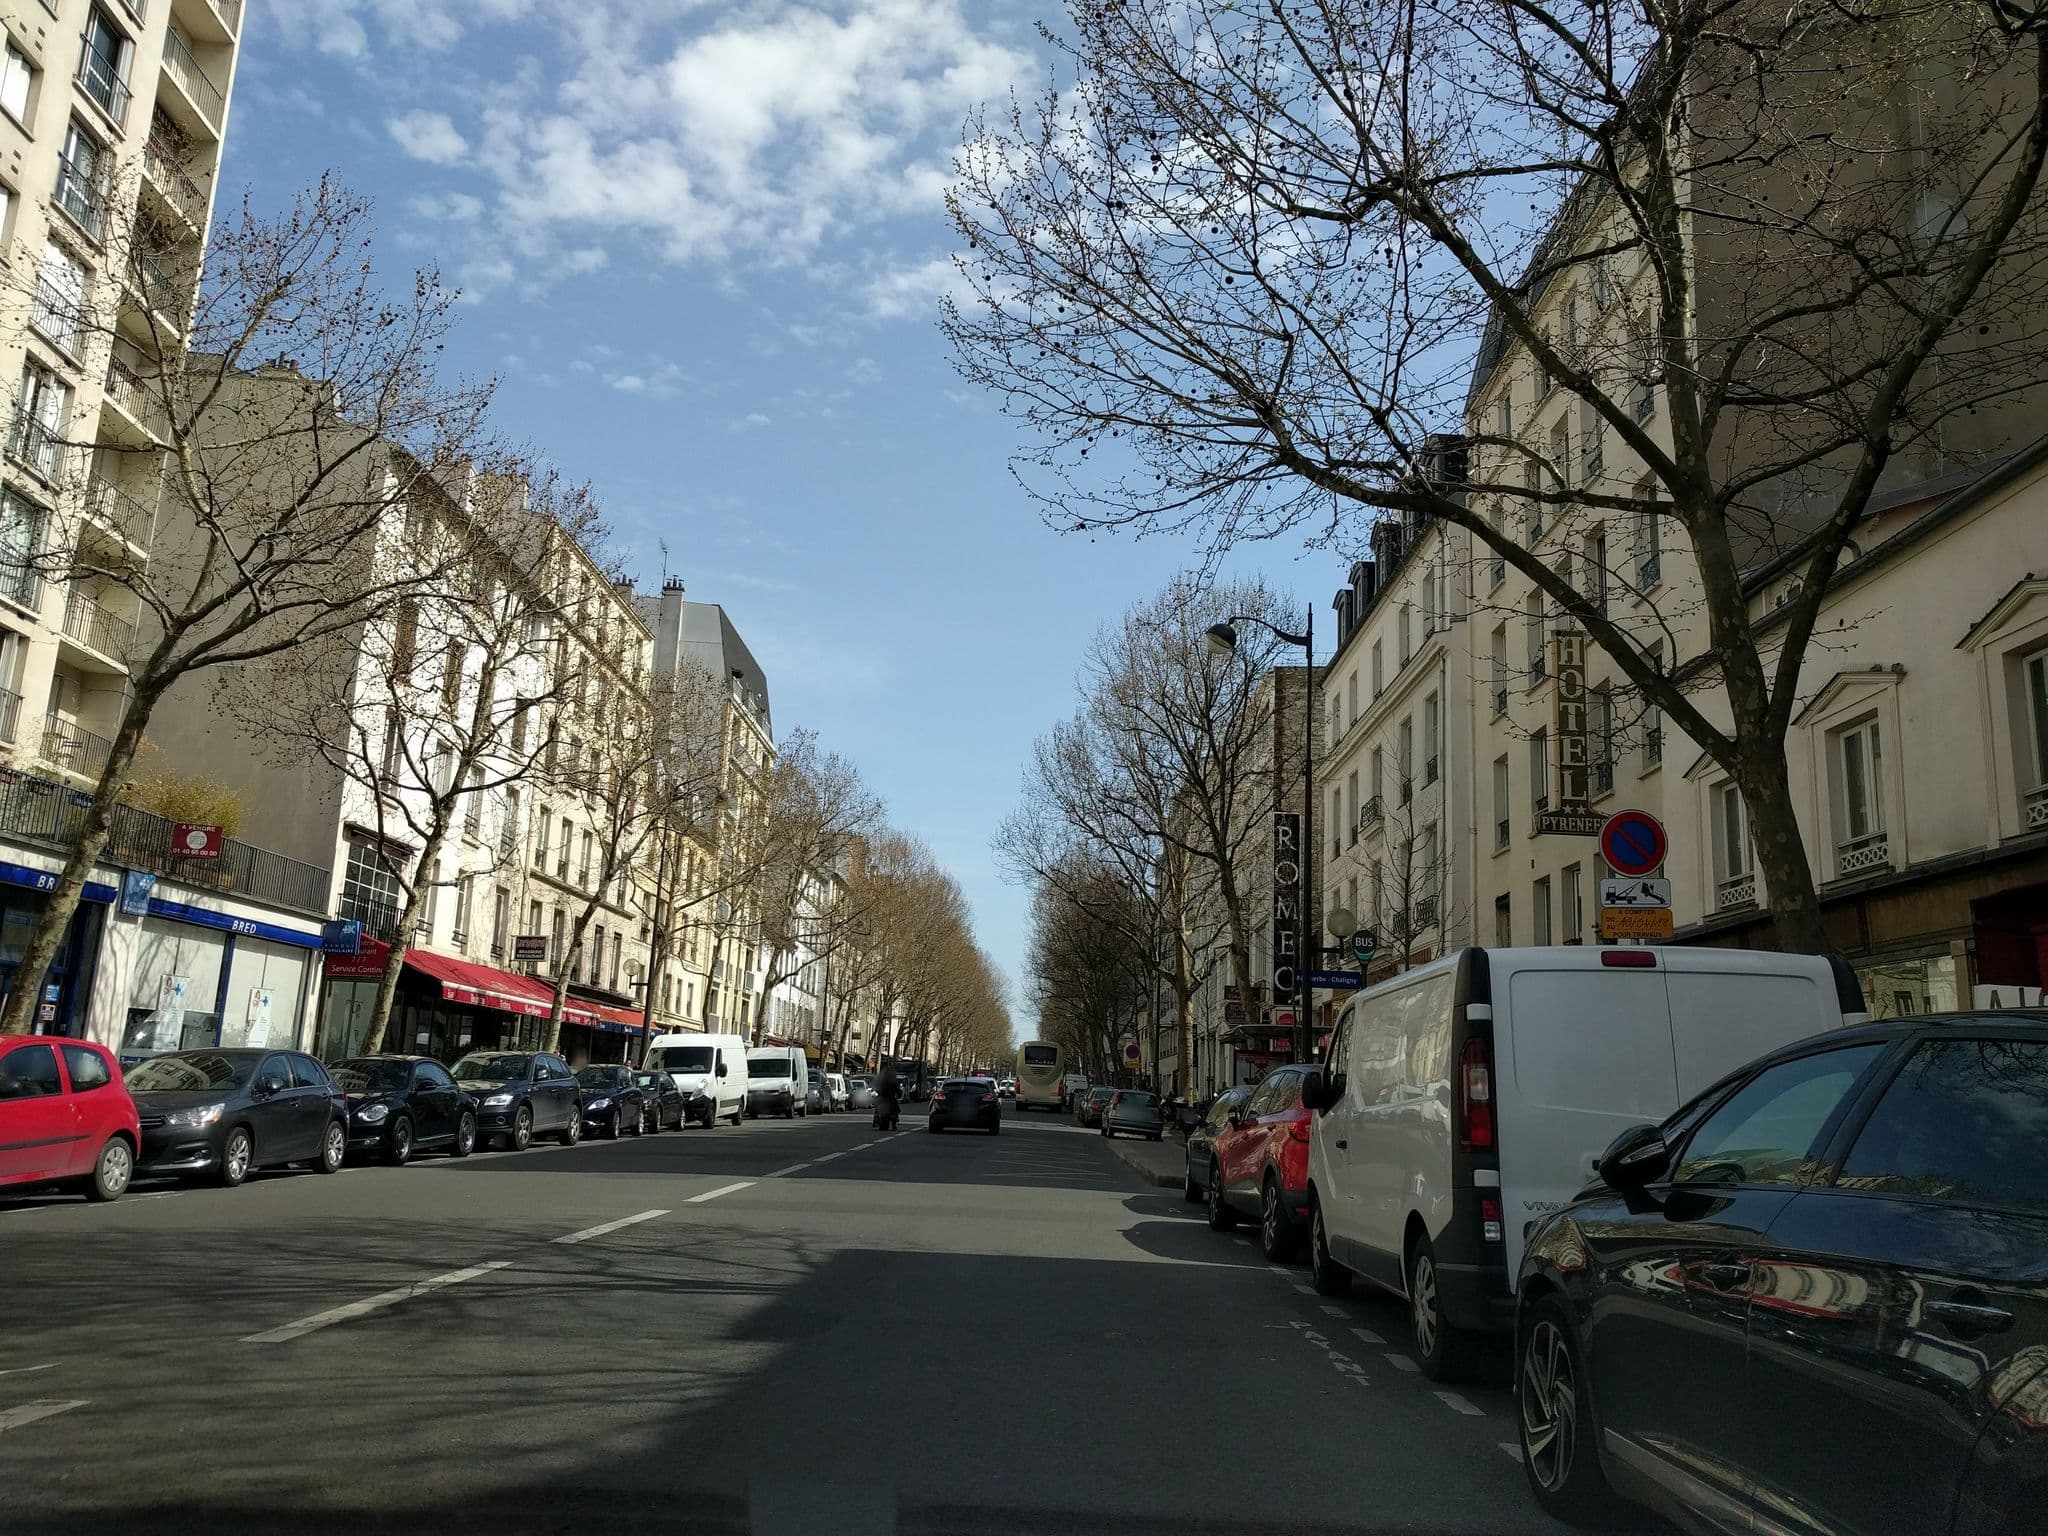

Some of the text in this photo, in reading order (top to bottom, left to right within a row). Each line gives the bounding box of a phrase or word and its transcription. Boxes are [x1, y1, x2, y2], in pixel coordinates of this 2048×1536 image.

[1558, 636, 1588, 801] HOTEL
[1541, 815, 1606, 833] PYRENEE
[37, 875, 56, 890] BR
[232, 919, 257, 934] BRED
[1355, 937, 1374, 947] BUS
[331, 964, 357, 973] Service
[1331, 976, 1358, 984] Chaligny
[1522, 1200, 1567, 1211] VIVA
